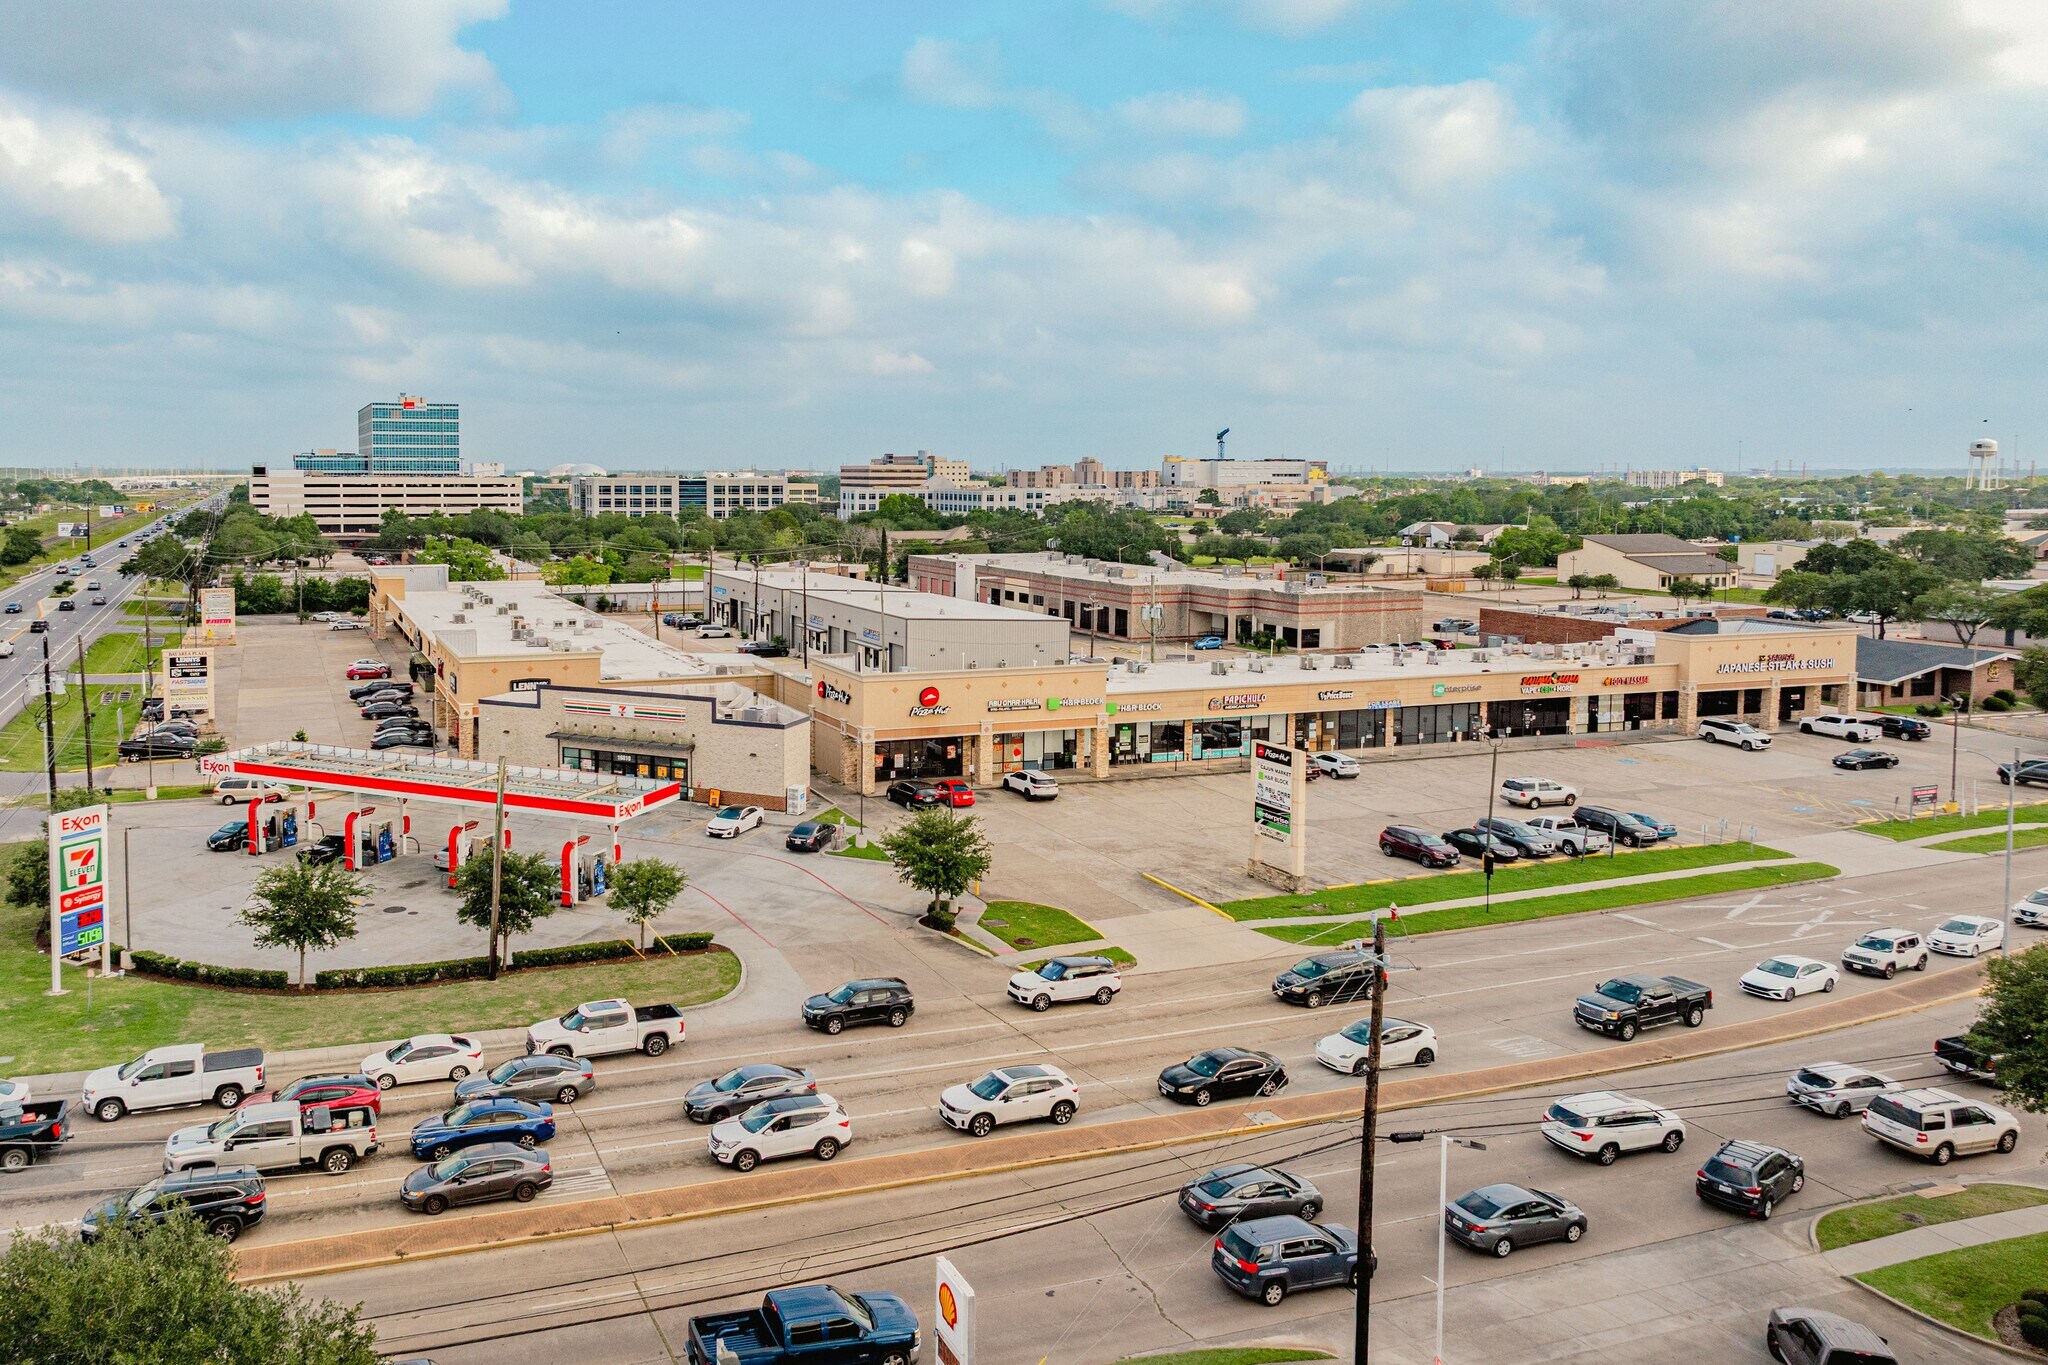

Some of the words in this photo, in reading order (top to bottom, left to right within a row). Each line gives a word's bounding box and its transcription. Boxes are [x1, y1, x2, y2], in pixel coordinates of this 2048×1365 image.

[1717, 662, 1767, 674] JAPANESE
[1768, 661, 1798, 671] STEAK
[1800, 660, 1806, 668] &
[1807, 658, 1835, 669] SUSHI
[1434, 684, 1482, 692] enterprise
[910, 706, 934, 717] Pizza
[934, 706, 951, 715] Hut
[1264, 749, 1279, 759] Pizza
[1279, 752, 1290, 762] Hut
[203, 759, 230, 774] Exxon
[1275, 768, 1291, 777] MARKET
[1275, 777, 1288, 785] BLOCK
[1277, 790, 1290, 798] OMAR
[619, 801, 642, 817] Exxon
[62, 814, 99, 831] Exxon
[71, 848, 94, 886] 7
[74, 892, 102, 904] Synergy
